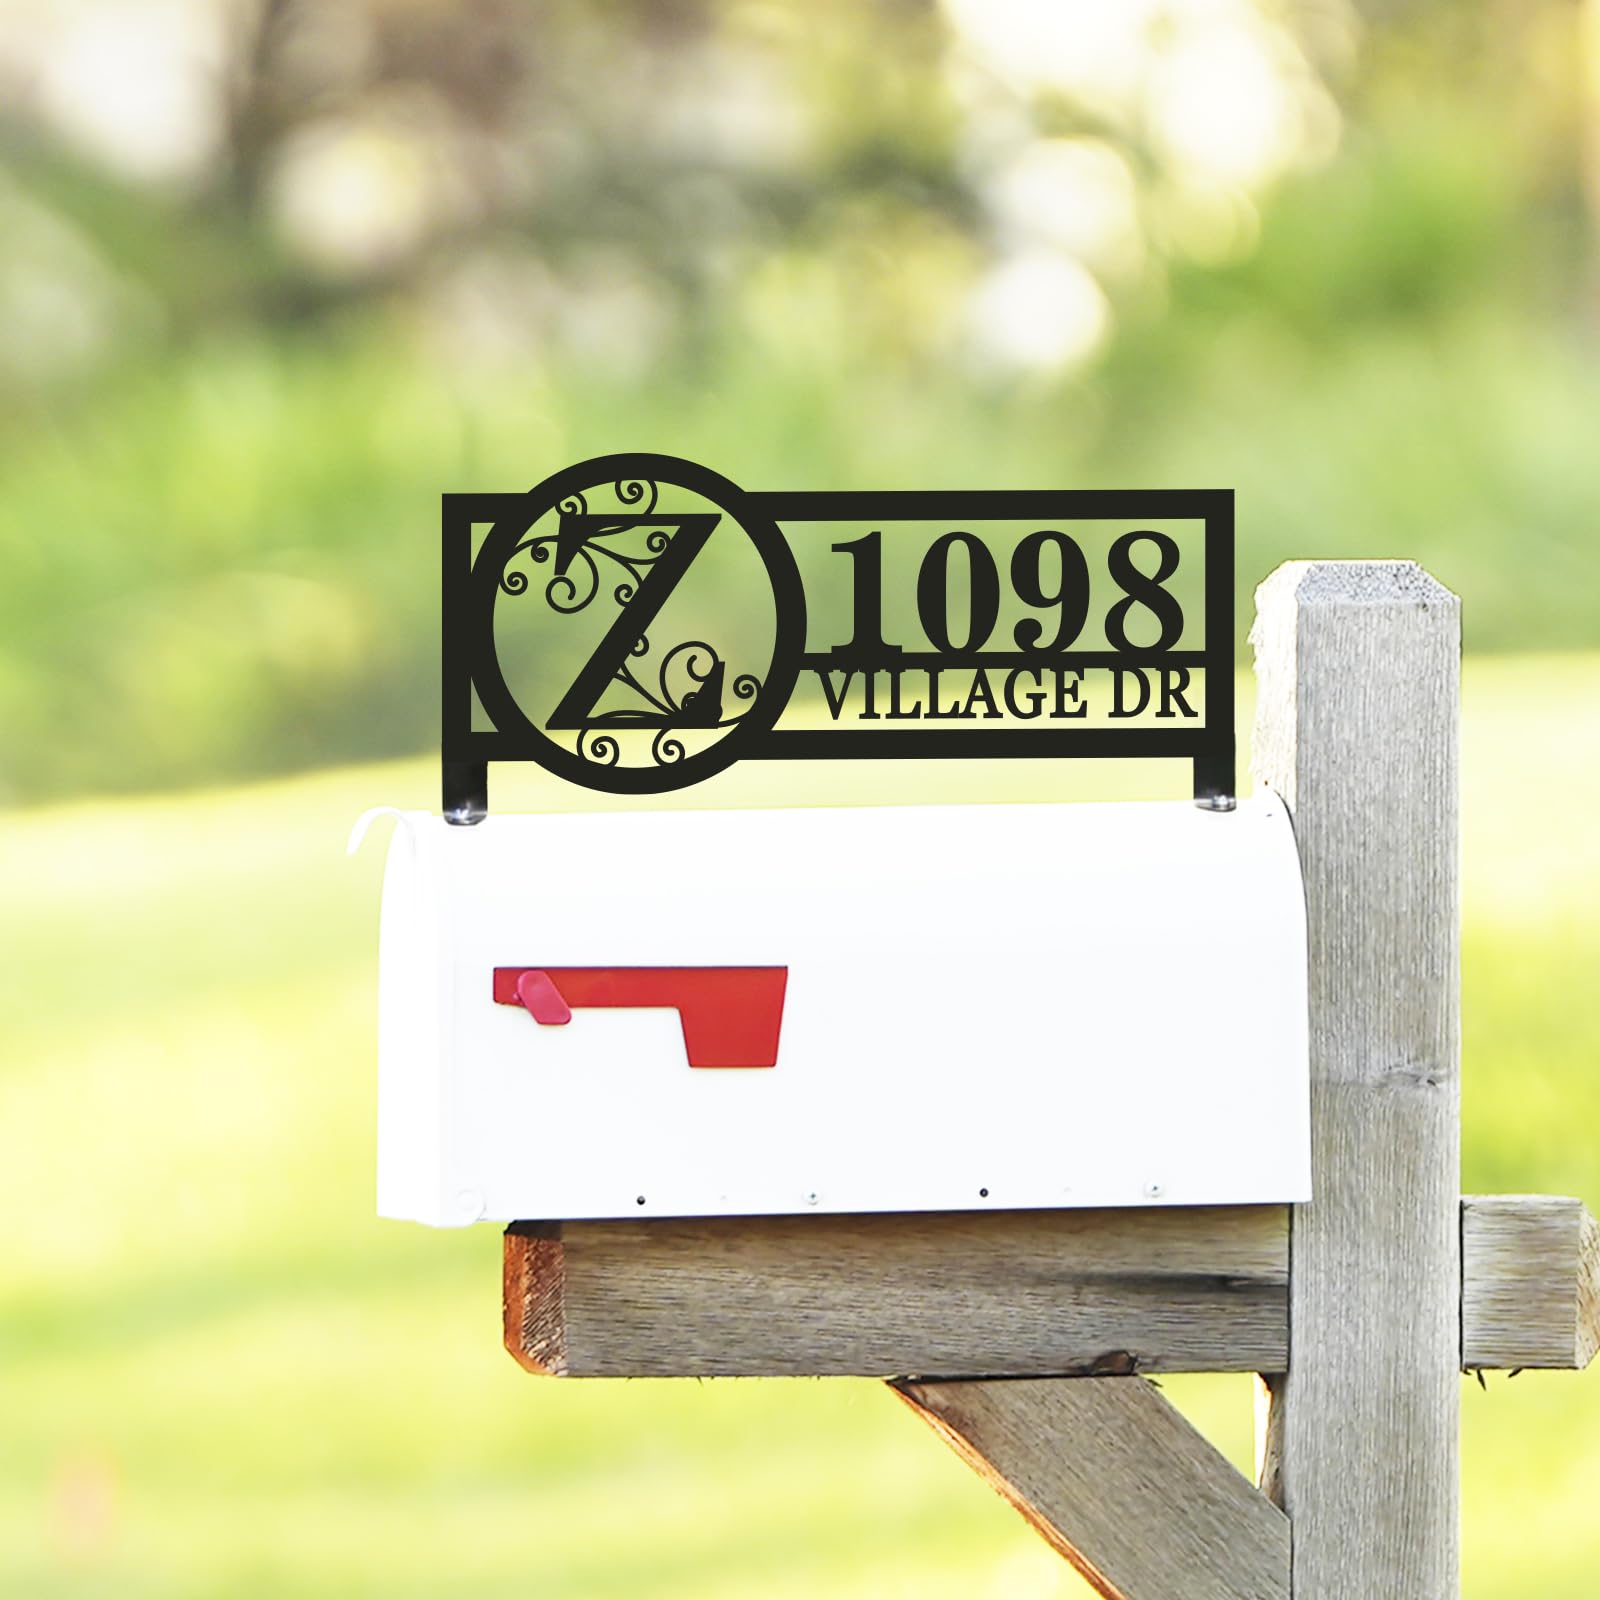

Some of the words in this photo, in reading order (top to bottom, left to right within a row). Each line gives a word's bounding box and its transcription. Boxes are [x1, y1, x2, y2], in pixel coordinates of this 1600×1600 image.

[545, 513, 726, 731] Z
[831, 530, 1185, 654] 1098
[813, 667, 1088, 720] VILLAGE
[1107, 666, 1199, 718] DR
